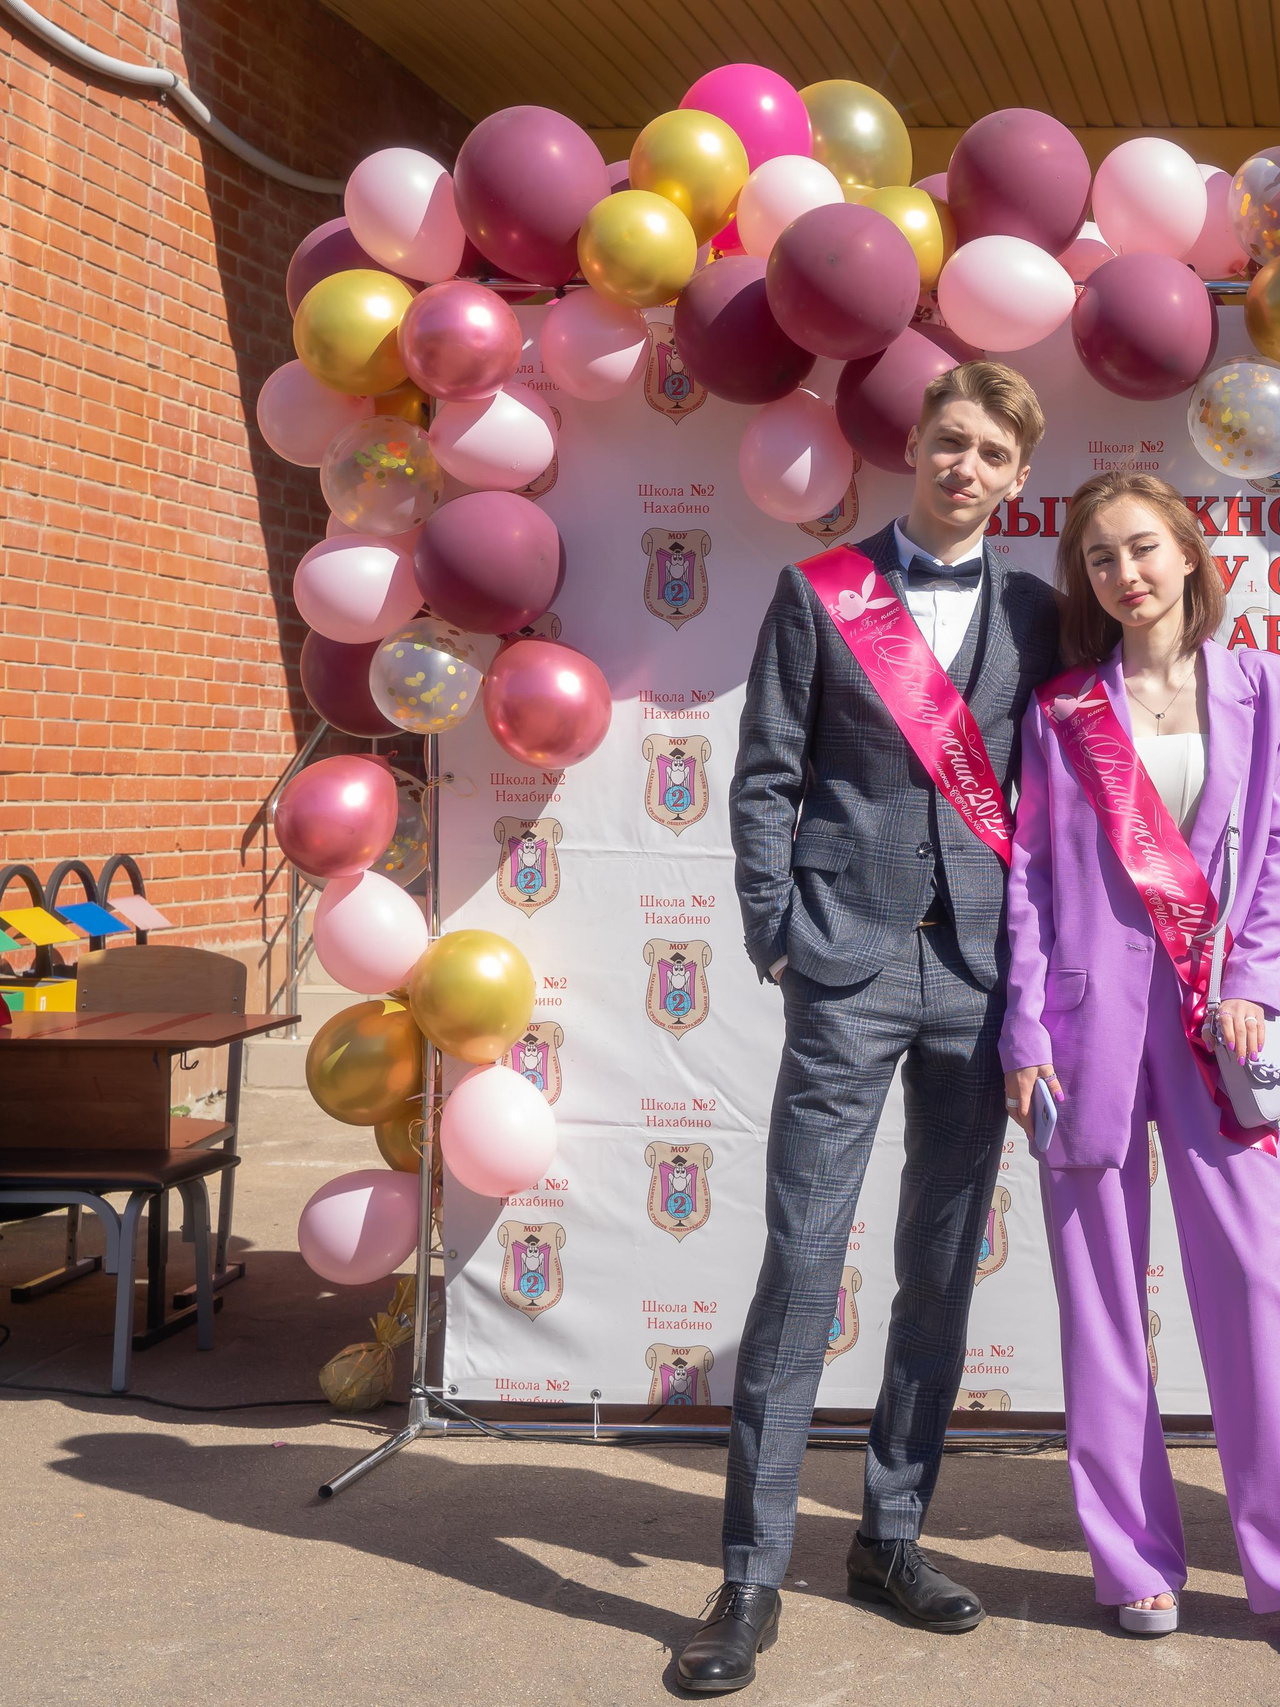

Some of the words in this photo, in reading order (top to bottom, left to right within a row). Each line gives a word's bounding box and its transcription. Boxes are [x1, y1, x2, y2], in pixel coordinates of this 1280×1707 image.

[1088, 441, 1134, 454] Школа
[1140, 440, 1165, 453] №2
[1093, 458, 1160, 471] Нахабино
[638, 484, 684, 498] Школа
[690, 484, 715, 497] №2
[643, 501, 710, 515] Нахабино
[670, 583, 684, 601] 2
[639, 690, 685, 703] Школа
[690, 690, 715, 703] №2
[643, 707, 710, 720] Нахабино
[668, 738, 689, 746] МОУ
[872, 634, 979, 791] Выпускник
[965, 788, 1014, 840] 2022
[490, 773, 536, 786] Школа
[542, 773, 566, 786] №2
[495, 791, 561, 803] Нахабино
[671, 789, 684, 807] 2
[1080, 733, 1187, 900] Выпускница
[520, 821, 540, 829] МОУ
[523, 871, 536, 889] 2
[639, 895, 685, 908] Школа
[691, 895, 716, 908] №2
[644, 913, 711, 925] Нахабино
[543, 977, 567, 989] №2
[672, 993, 685, 1011] 2
[640, 1098, 686, 1111] Школа
[691, 1098, 717, 1111] №2
[645, 1116, 712, 1128] Нахабино
[545, 1178, 569, 1191] №2
[673, 1196, 686, 1214] 2
[523, 1225, 544, 1233] МОУ
[526, 1275, 539, 1293] 2
[641, 1301, 688, 1314] Школа
[693, 1301, 717, 1314] №2
[646, 1317, 713, 1330] Нахабино
[671, 1348, 691, 1356] МОУ
[990, 1345, 1014, 1358] №2
[963, 1362, 1009, 1374] хабино
[495, 1379, 540, 1391] Школа
[546, 1379, 570, 1391] №2
[967, 1391, 988, 1399] МОУ
